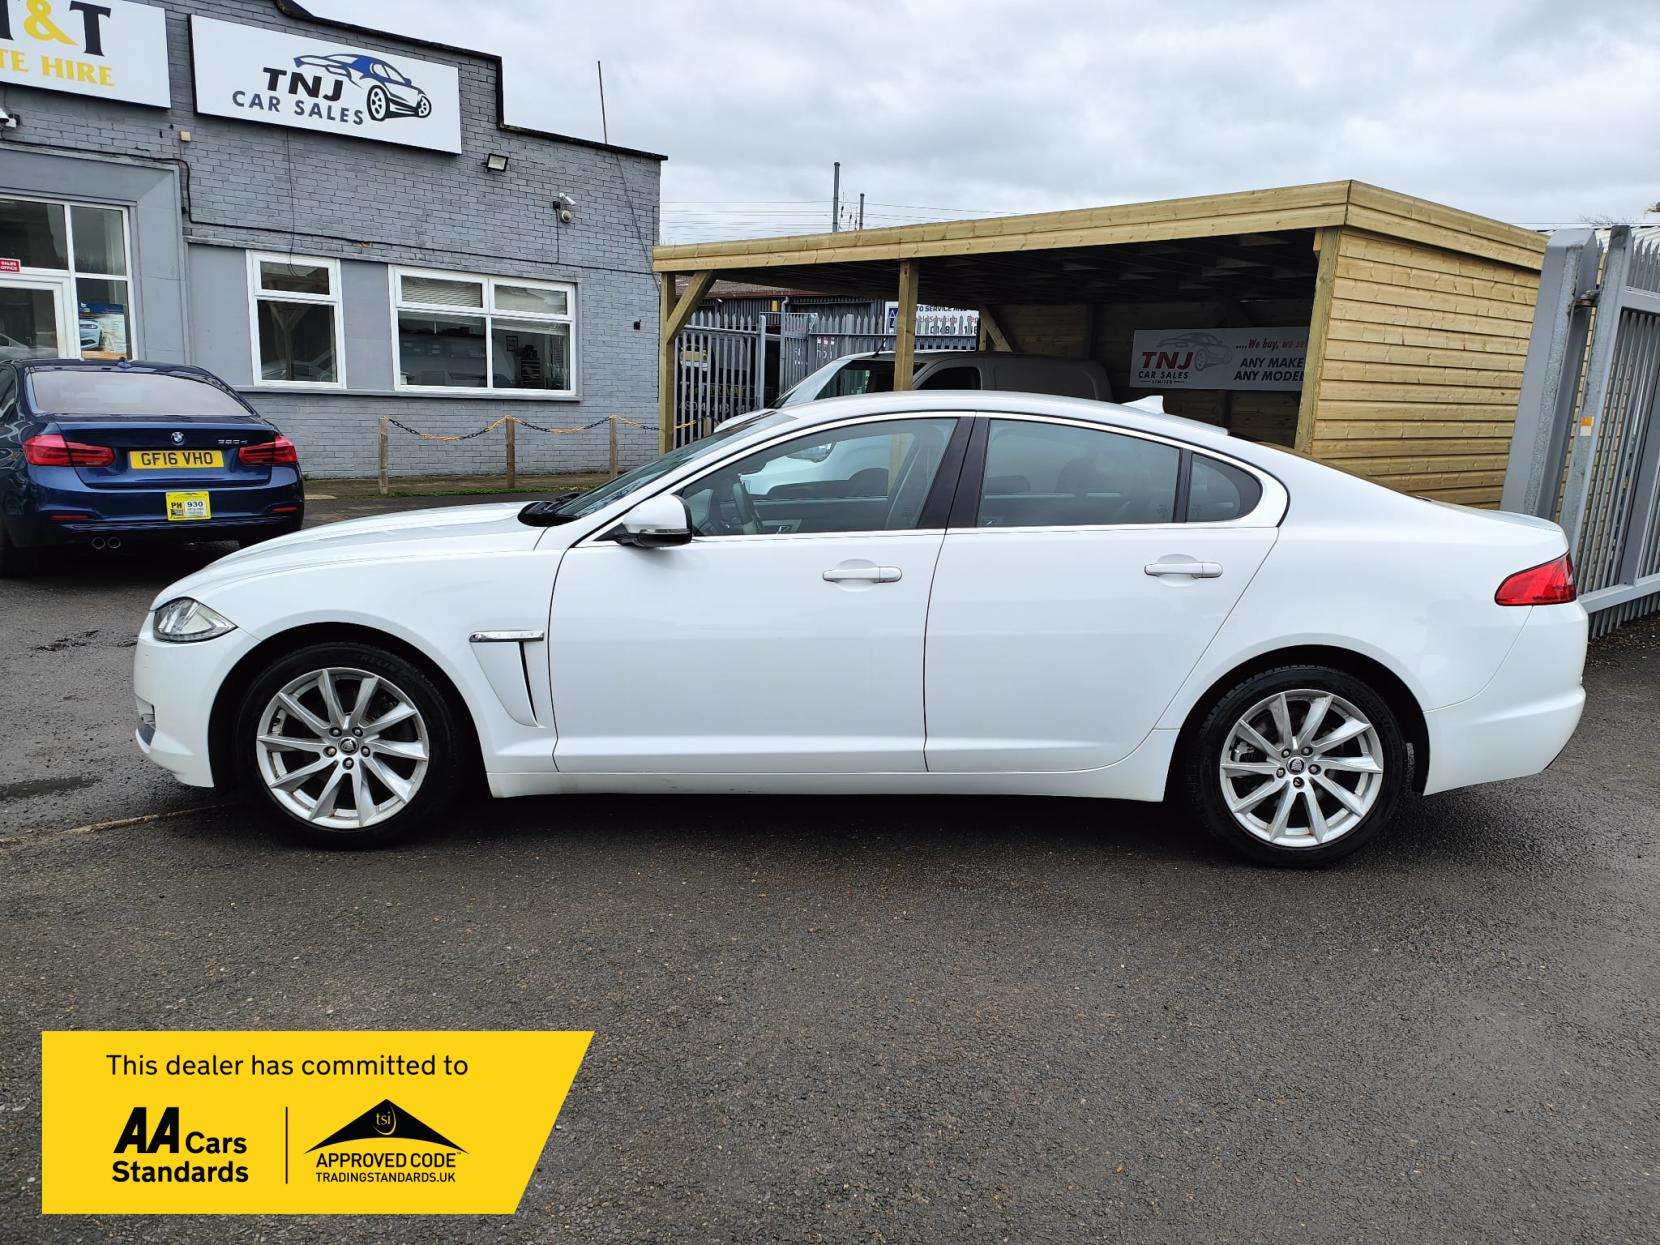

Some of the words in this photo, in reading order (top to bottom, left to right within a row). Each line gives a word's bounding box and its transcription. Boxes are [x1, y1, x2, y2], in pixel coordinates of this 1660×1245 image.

[41, 55, 115, 87] HIRE
[263, 67, 343, 101] TNJ
[232, 90, 281, 112] CAR
[294, 100, 364, 125] SALES
[1142, 352, 1194, 370] TNJ
[1240, 358, 1265, 368] ANY
[1267, 357, 1305, 368] MAKE
[1138, 371, 1156, 379] CAR
[1160, 371, 1189, 379] SALES
[1233, 370, 1260, 380] ANY
[140, 452, 178, 466] GF16
[181, 451, 213, 465] VHO
